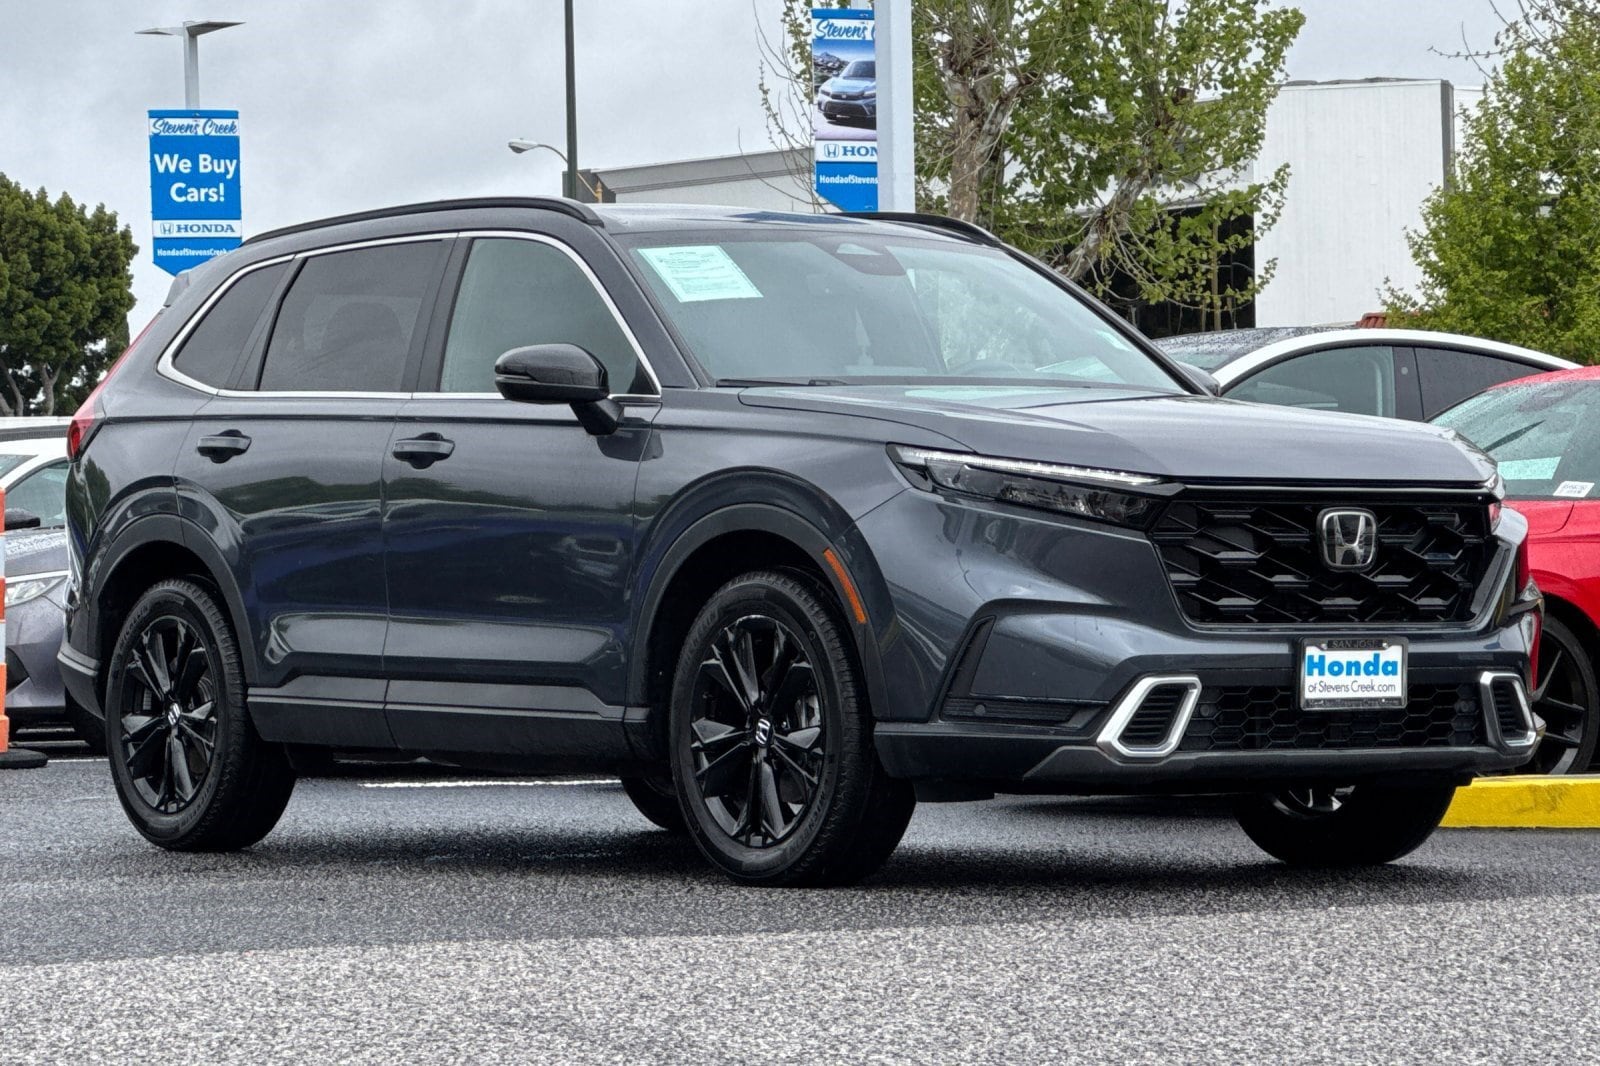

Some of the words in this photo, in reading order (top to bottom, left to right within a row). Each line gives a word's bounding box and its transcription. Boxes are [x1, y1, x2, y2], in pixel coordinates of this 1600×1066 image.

[815, 18, 868, 40] Stevens
[152, 118, 200, 136] Stevens
[202, 118, 237, 136] Creek
[153, 153, 192, 173] We
[198, 153, 237, 179] Buy
[169, 182, 225, 203] Cars!
[176, 224, 236, 233] HONDA
[1306, 653, 1398, 677] Honda
[1308, 682, 1318, 693] of
[1318, 680, 1350, 693] Stevens
[1351, 679, 1396, 693] Creek.com
